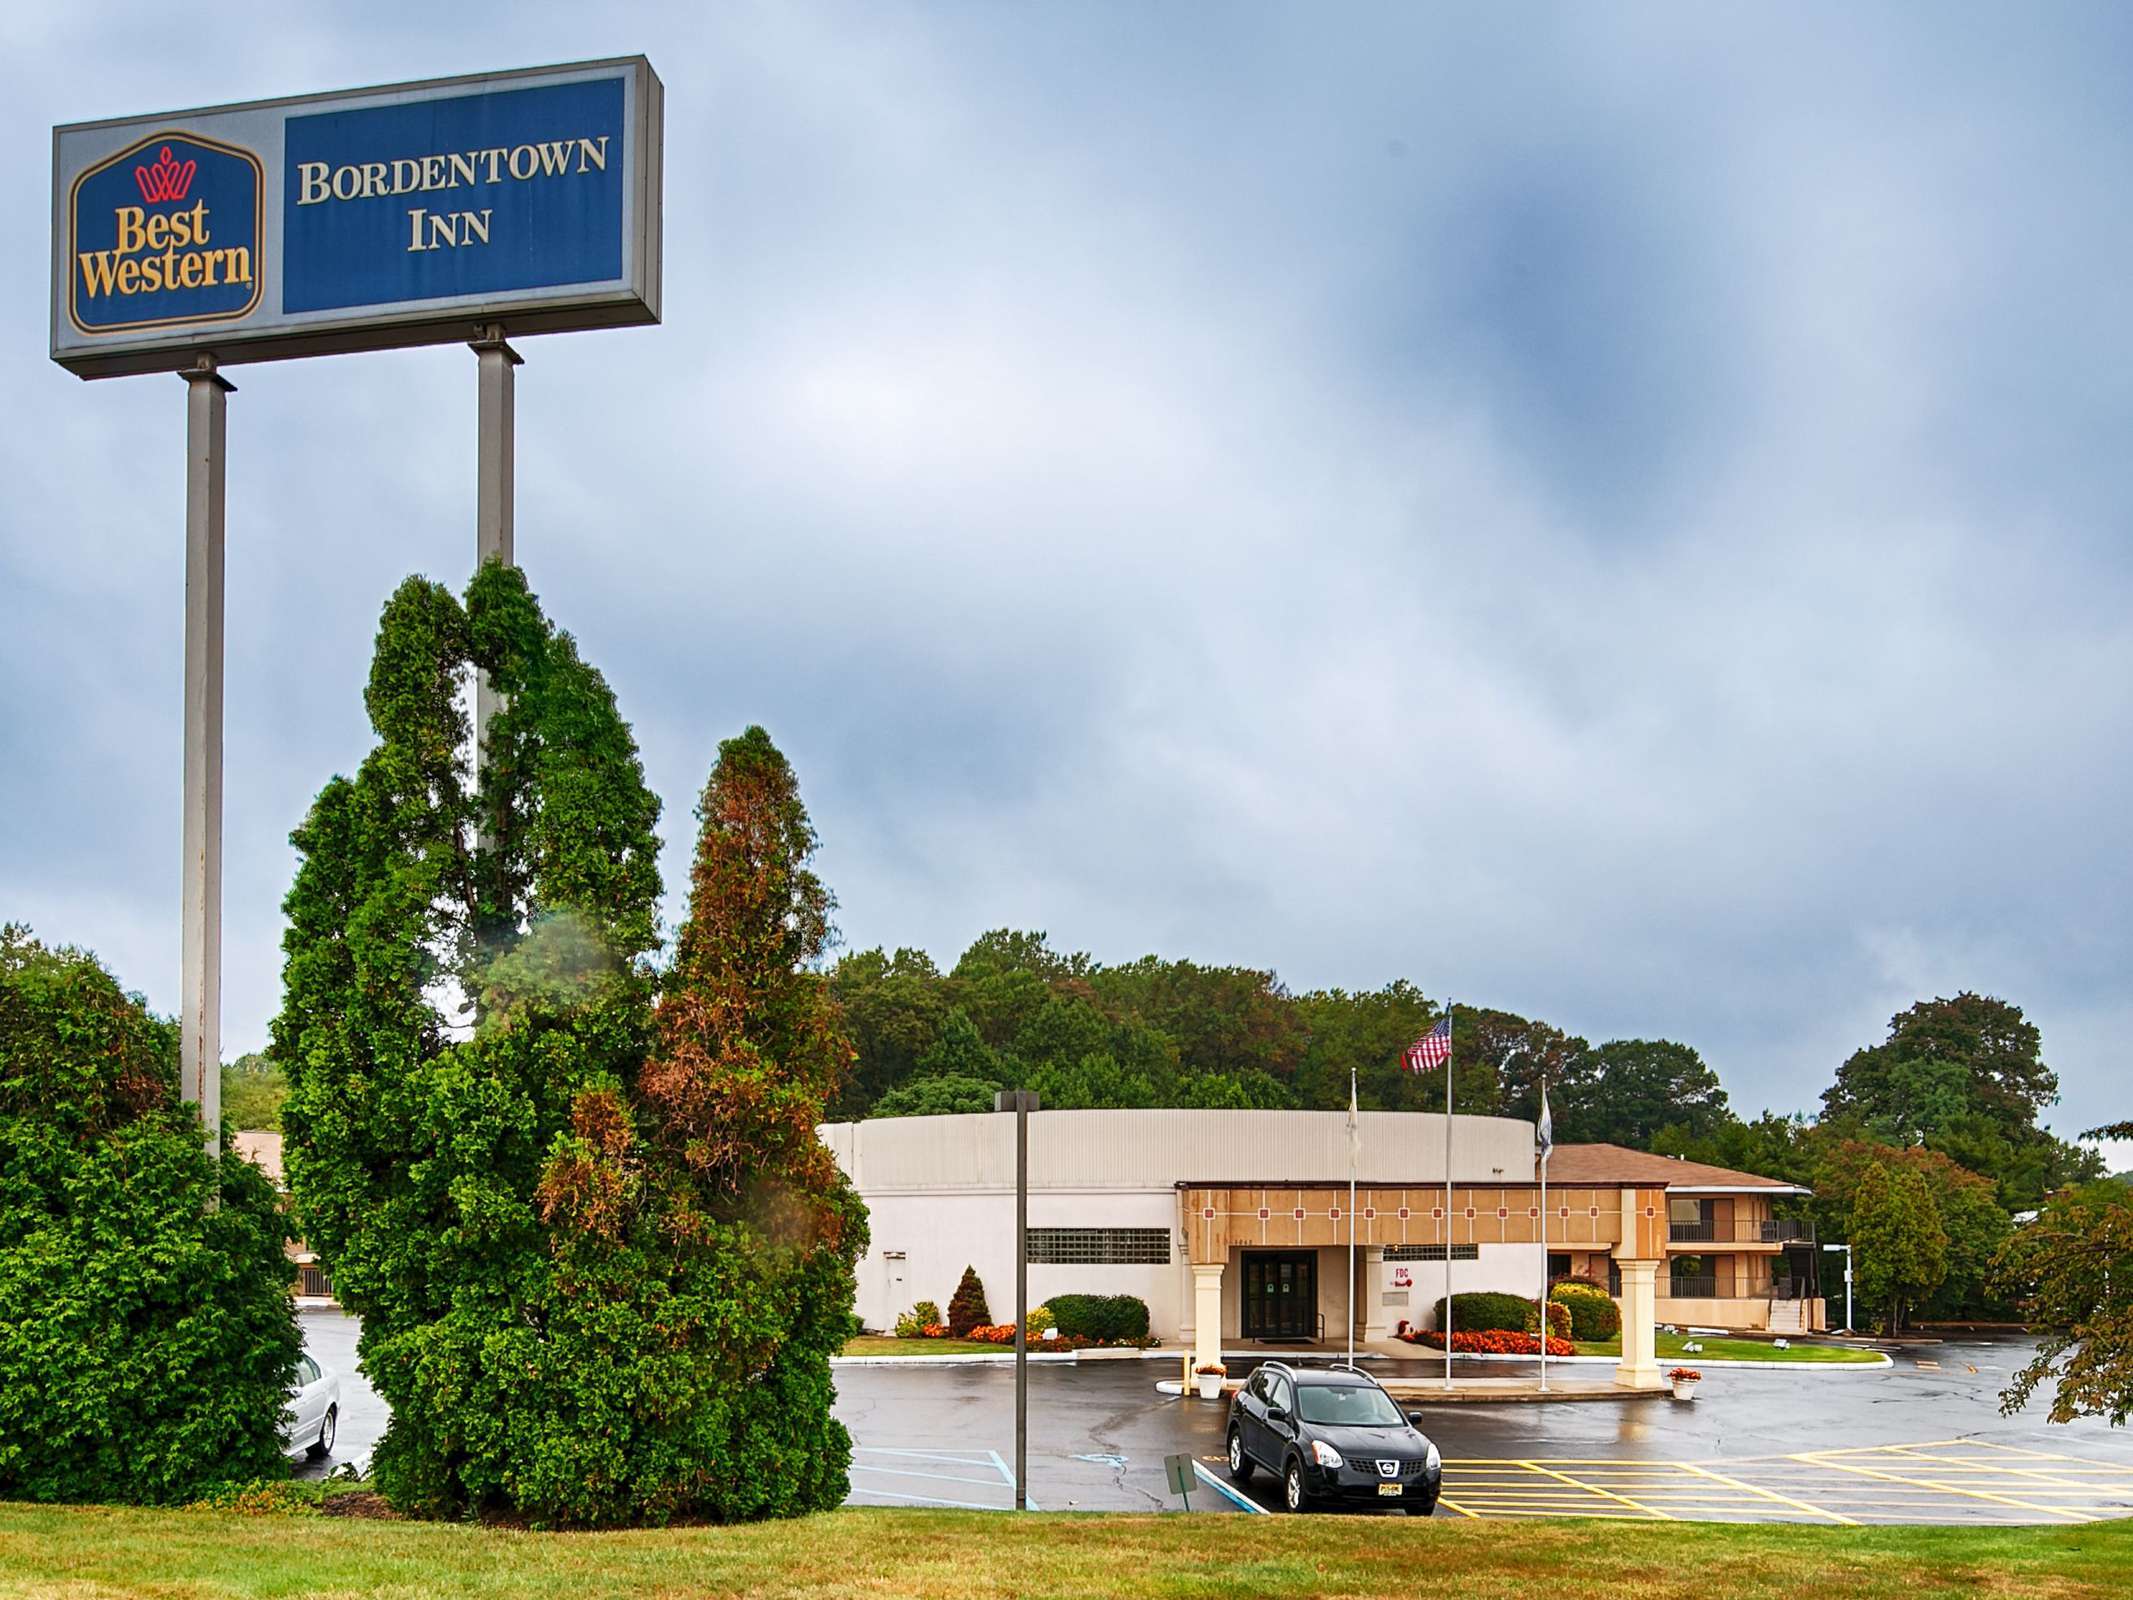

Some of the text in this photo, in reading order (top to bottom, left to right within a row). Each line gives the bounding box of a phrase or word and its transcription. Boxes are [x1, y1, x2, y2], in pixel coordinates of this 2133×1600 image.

[297, 136, 609, 205] BORDENTOWN
[115, 198, 210, 254] Best
[407, 208, 493, 251] INN
[78, 235, 253, 298] Western
